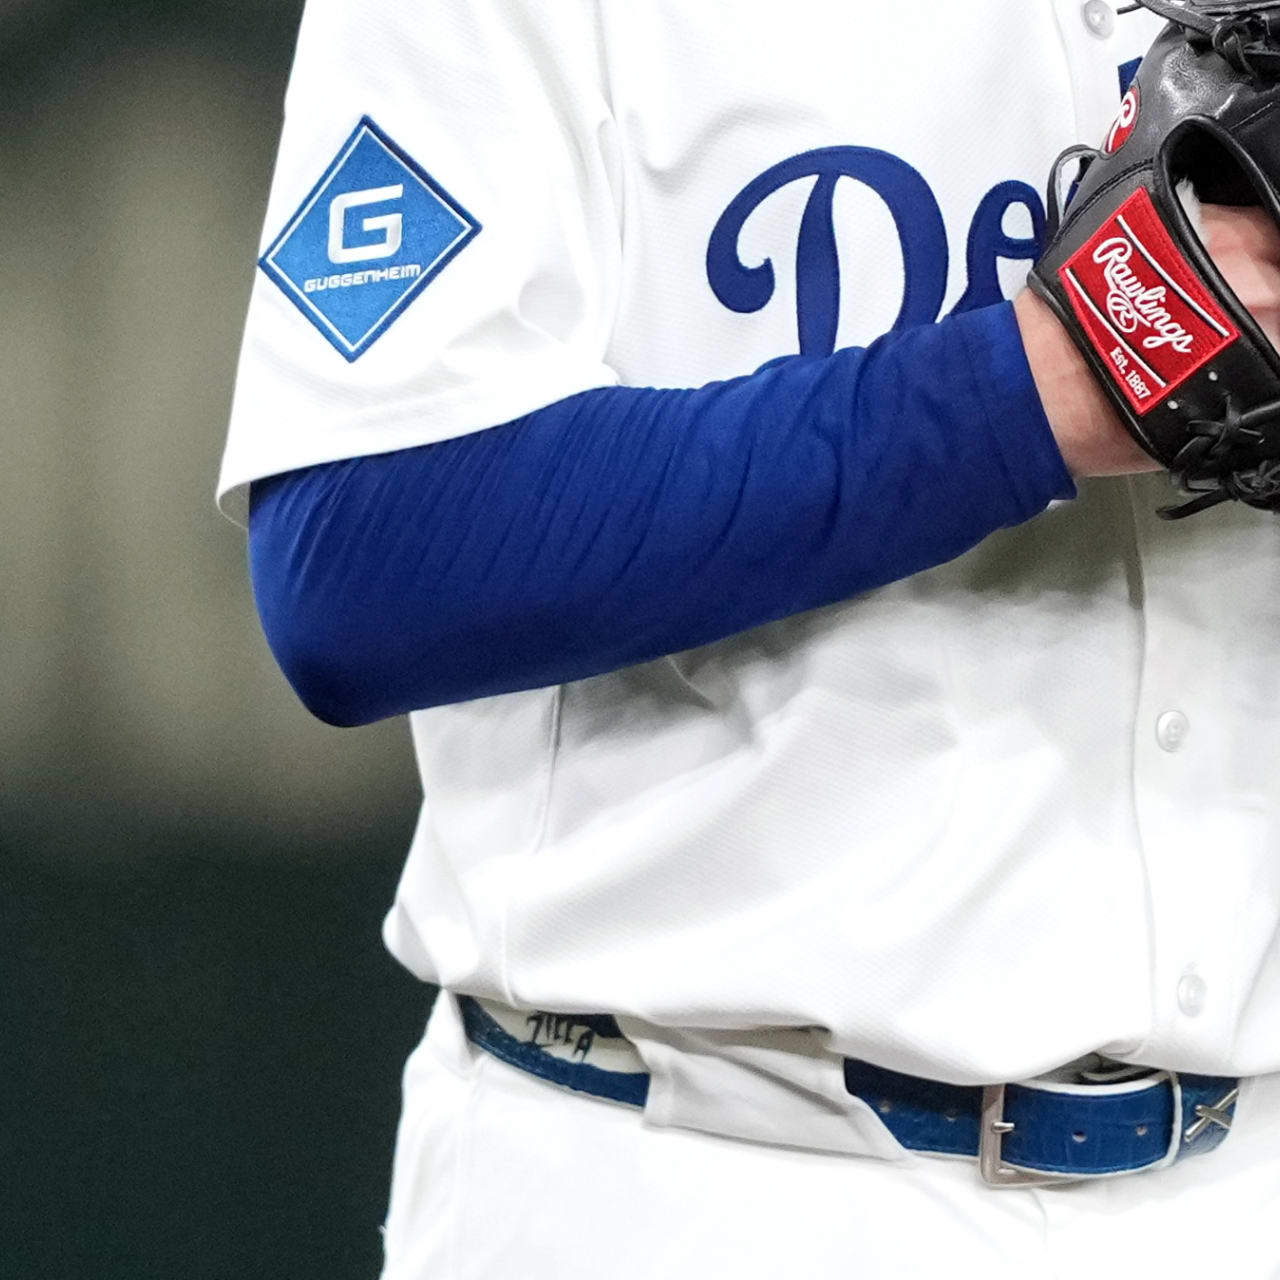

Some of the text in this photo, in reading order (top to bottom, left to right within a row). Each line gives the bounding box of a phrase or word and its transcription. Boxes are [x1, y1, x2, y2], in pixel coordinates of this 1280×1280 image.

[328, 183, 404, 264] G
[303, 263, 422, 294] GUGGENHEIM
[1092, 237, 1195, 354] Rawlings
[1125, 369, 1152, 399] 1887
